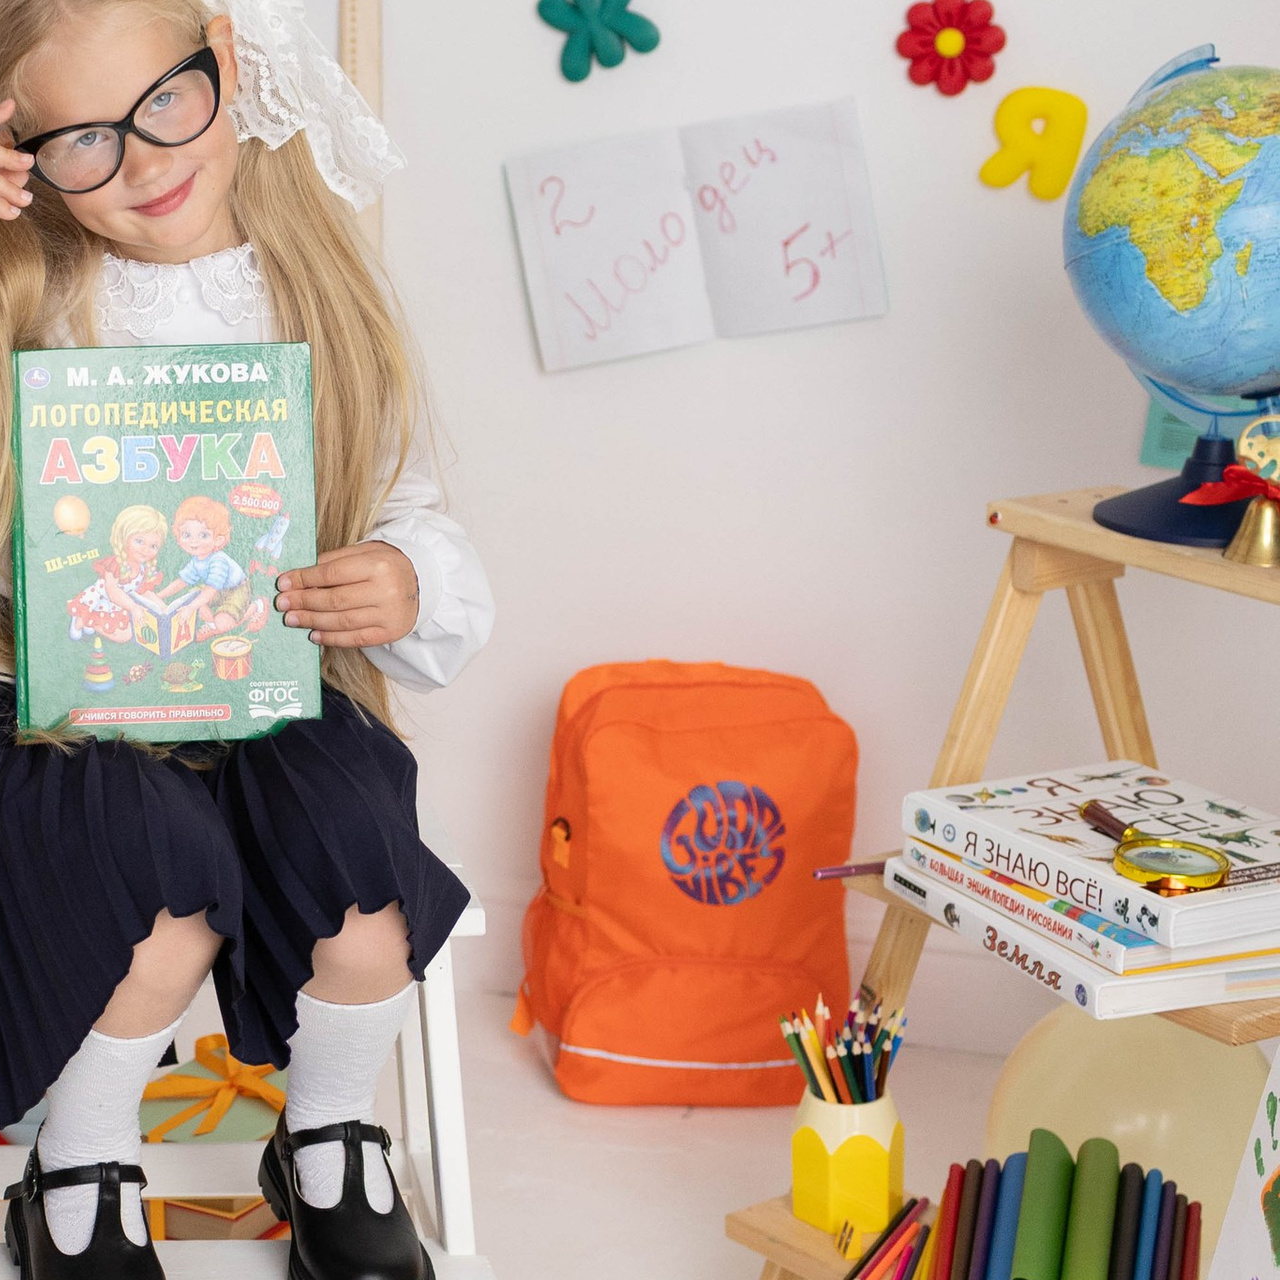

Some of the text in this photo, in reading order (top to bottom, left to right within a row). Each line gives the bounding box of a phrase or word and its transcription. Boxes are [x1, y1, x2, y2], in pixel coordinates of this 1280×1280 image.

[979, 86, 1088, 201] Я
[539, 175, 596, 236] 2
[66, 366, 98, 387] М.
[106, 365, 134, 386] А.
[143, 362, 269, 386] ЖУКОВА
[29, 399, 289, 429] ЛОГОПЕДИЧЕСКАЯ
[40, 432, 286, 485] АЗБУКА
[78, 708, 225, 722] УЧИМСЯ ГОВОРИТЬ ПРАВИЛЬНО
[248, 687, 300, 703] ФГОС
[929, 859, 965, 886] БОЛЬШАЯ
[966, 877, 1025, 917] ЭНЦИКЛОПЕДИЯ
[1026, 908, 1073, 941] РИСОВАНИЯ
[964, 830, 1103, 913] Я ЗНАЮ ВСЁ!
[983, 925, 1062, 990] Земля
